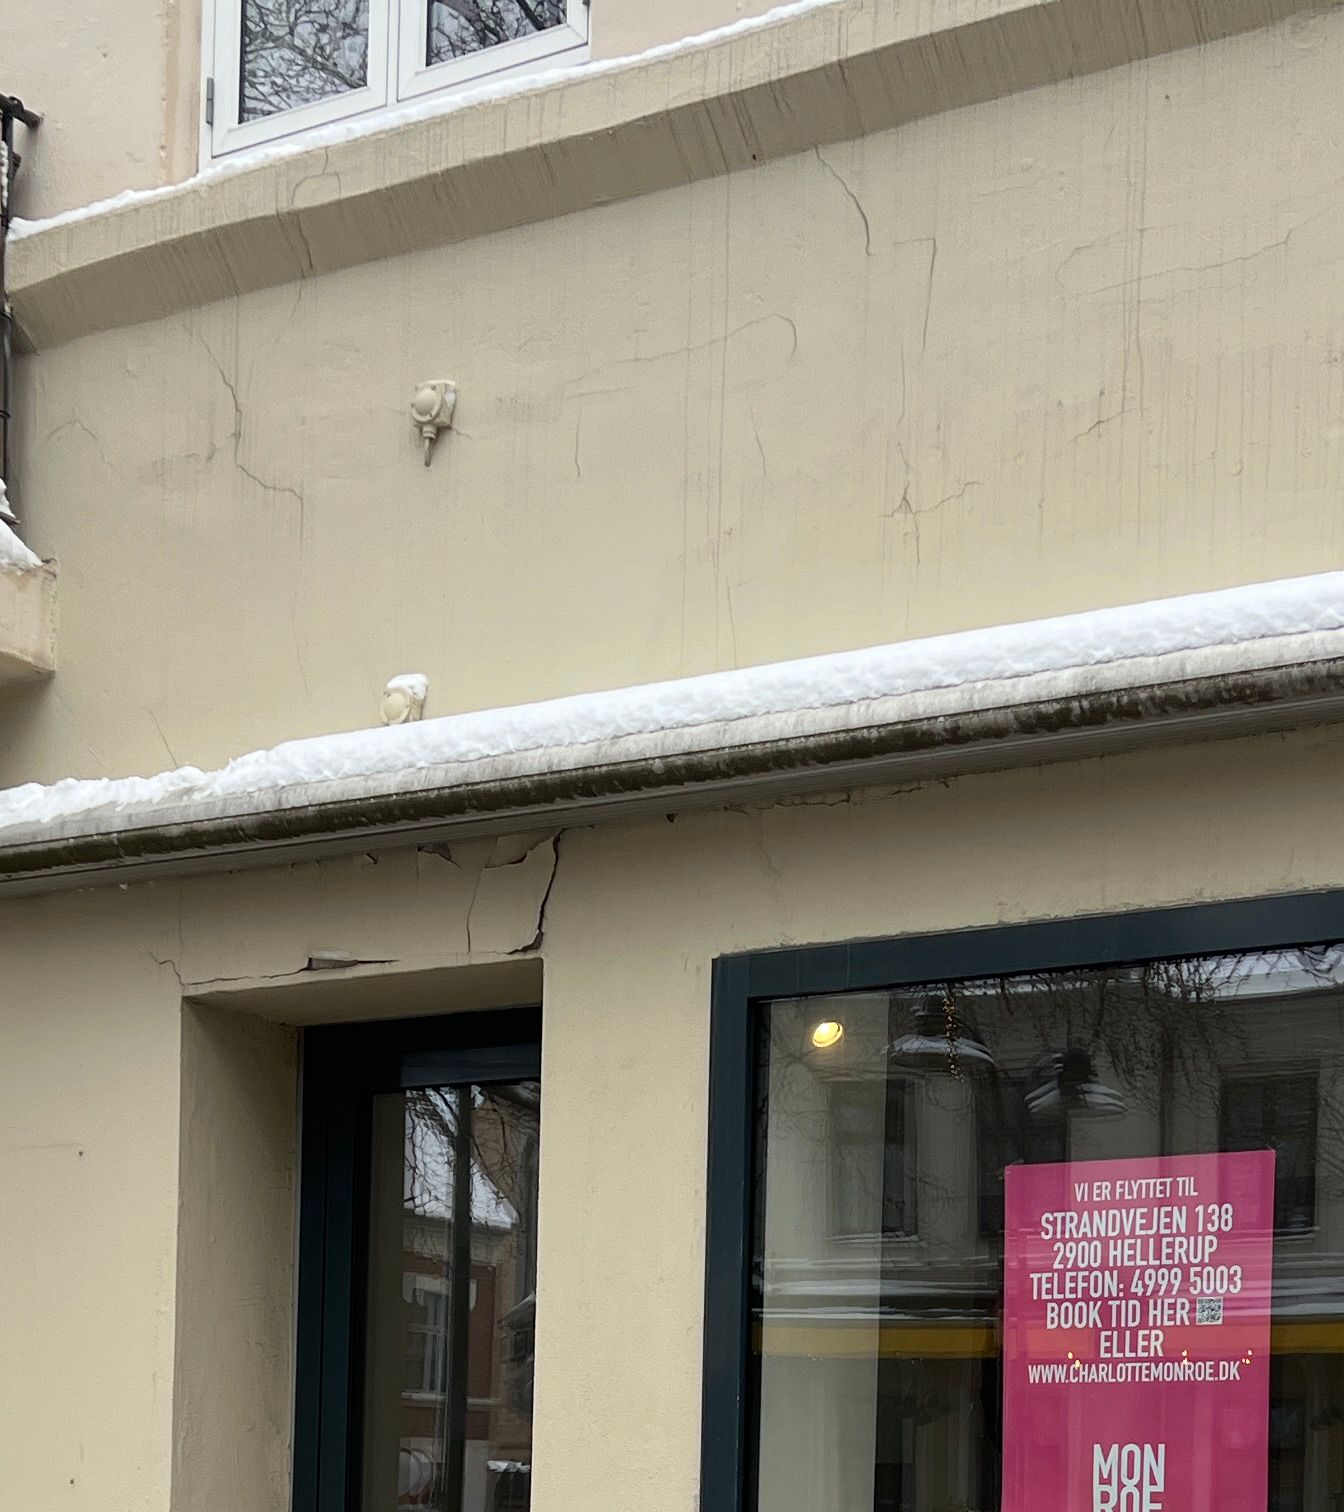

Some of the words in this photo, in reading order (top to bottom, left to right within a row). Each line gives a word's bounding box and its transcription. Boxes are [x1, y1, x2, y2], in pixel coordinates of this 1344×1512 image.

[1075, 1183, 1088, 1202] VI
[1093, 1181, 1111, 1201] ER
[1116, 1177, 1173, 1200] FLYTTET
[1177, 1176, 1198, 1197] TIL
[1040, 1206, 1187, 1240] STRANDVEJEN
[1195, 1203, 1233, 1233] 138
[1053, 1241, 1102, 1269] 2900
[1109, 1235, 1218, 1267] HELLERUP
[1030, 1270, 1124, 1300] TELEFON:
[1131, 1268, 1182, 1296] 4999
[1189, 1265, 1242, 1295] 5003
[1046, 1301, 1102, 1329] BOOK
[1108, 1300, 1140, 1328] TID
[1148, 1298, 1190, 1326] HER
[1099, 1330, 1164, 1358] ELLER
[1028, 1361, 1240, 1383] WWW.CHARLOTTEMONROE.DK
[1093, 1443, 1165, 1492] MON
